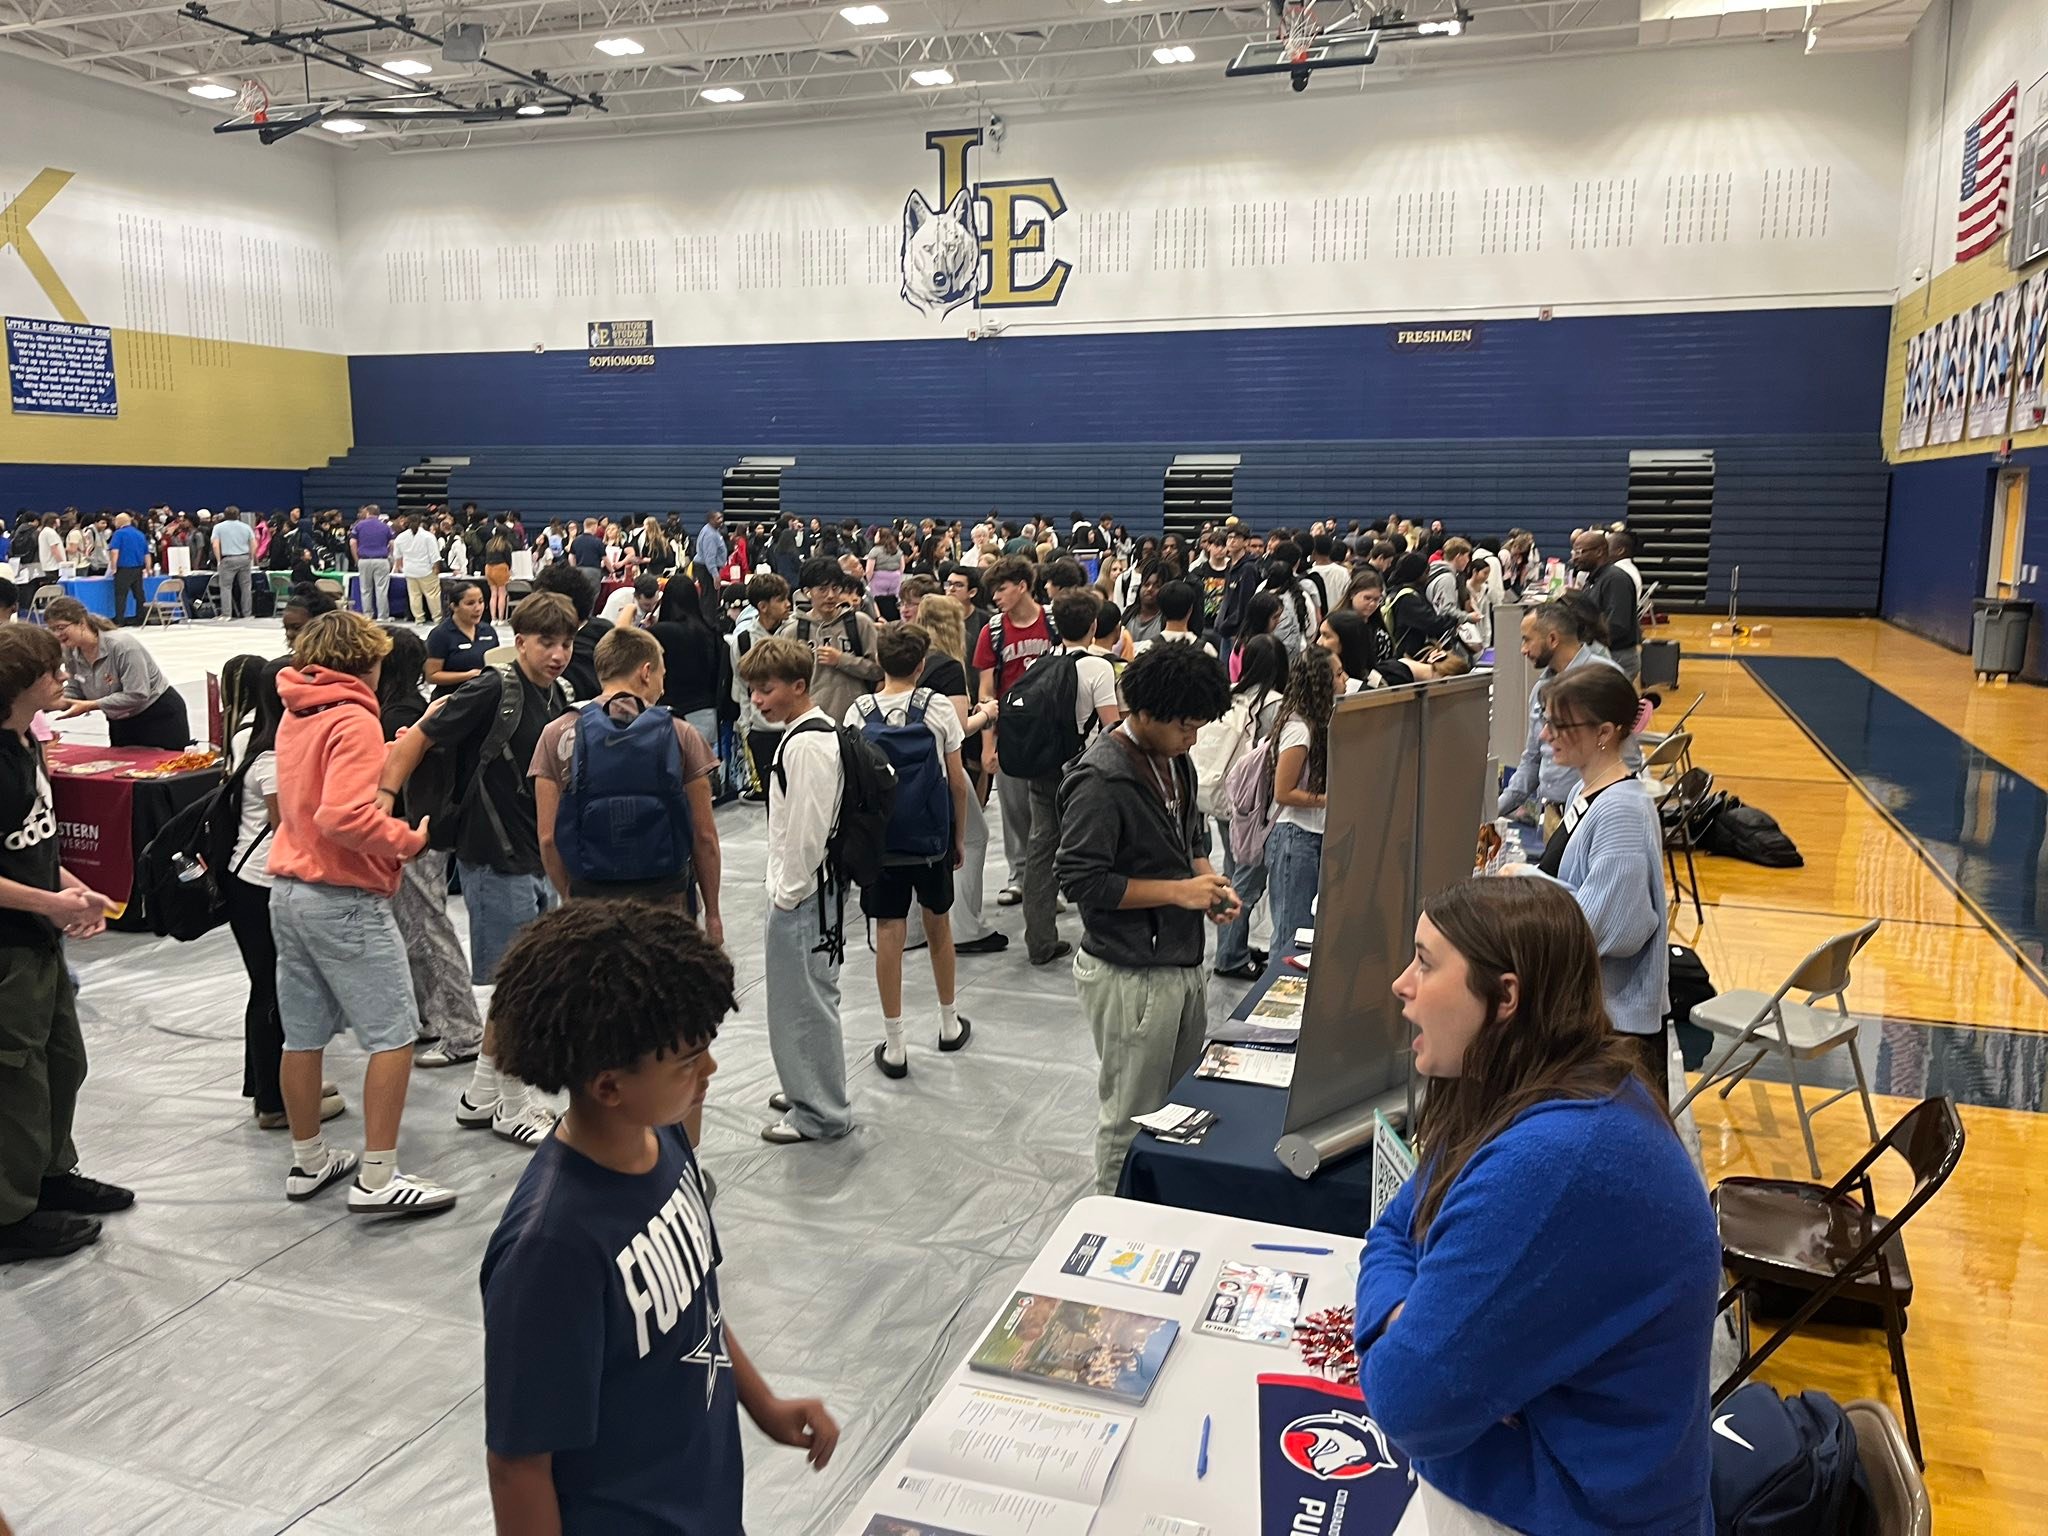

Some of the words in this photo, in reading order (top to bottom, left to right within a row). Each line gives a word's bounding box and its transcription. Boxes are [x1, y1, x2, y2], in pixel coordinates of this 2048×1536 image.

[6, 319, 30, 328] LITTLE
[1397, 329, 1472, 344] FRESHMEN
[589, 355, 655, 368] SOPHOMORES
[58, 821, 99, 840] STERN
